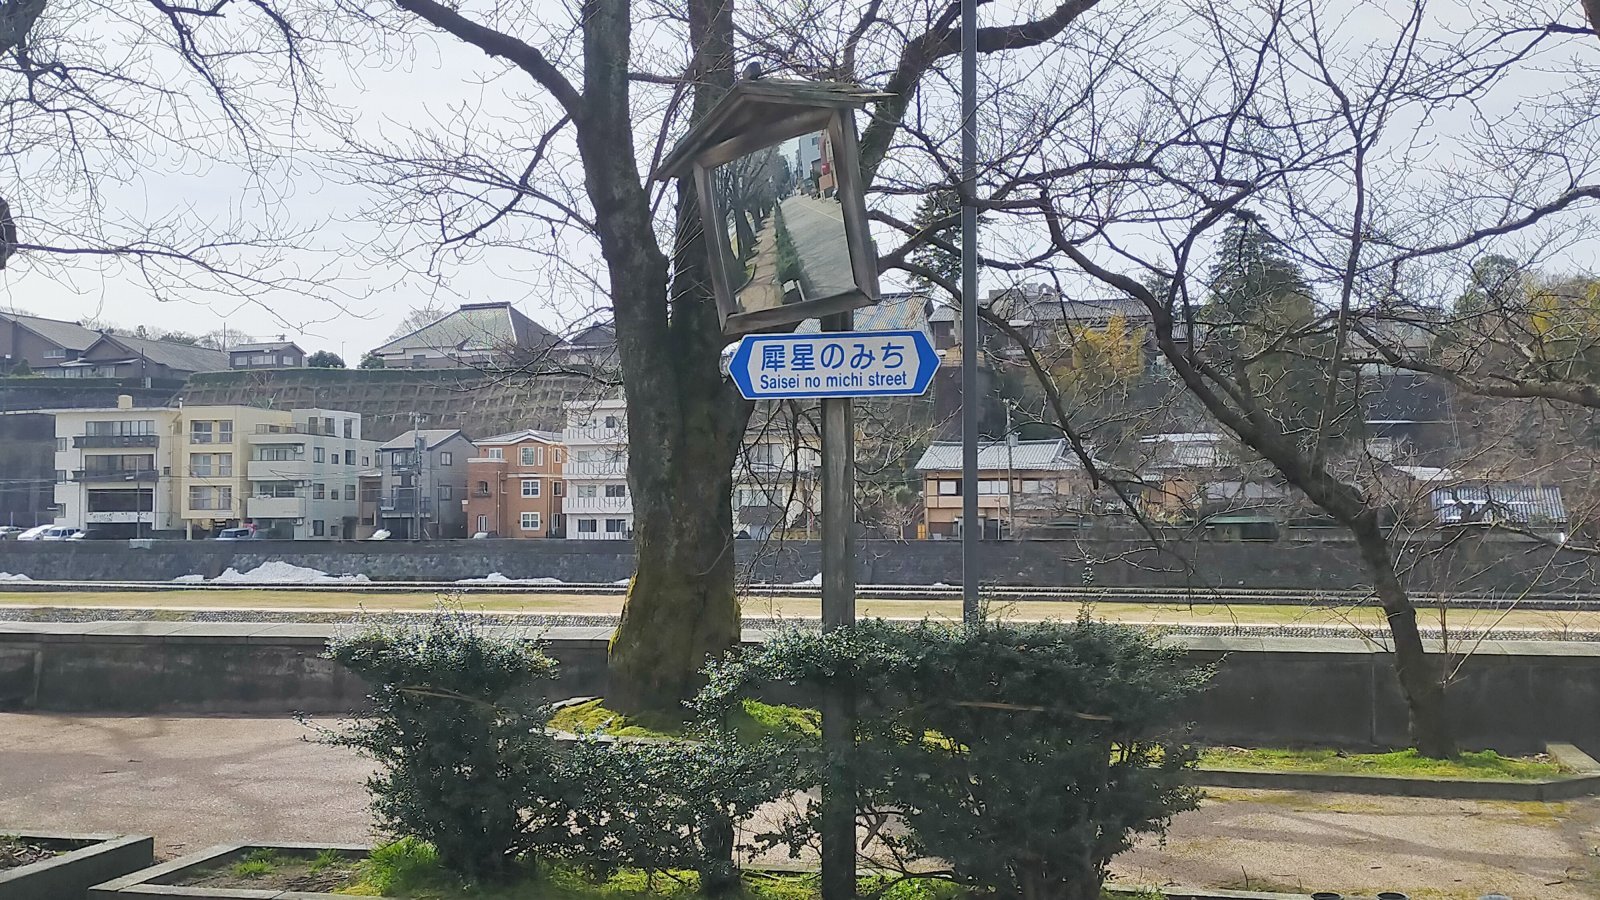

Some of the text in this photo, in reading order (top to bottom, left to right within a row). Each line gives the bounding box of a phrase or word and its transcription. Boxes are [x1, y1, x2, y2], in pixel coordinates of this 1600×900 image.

[761, 342, 905, 372] 犀星のみち
[760, 371, 907, 389] Saisei no michi street
